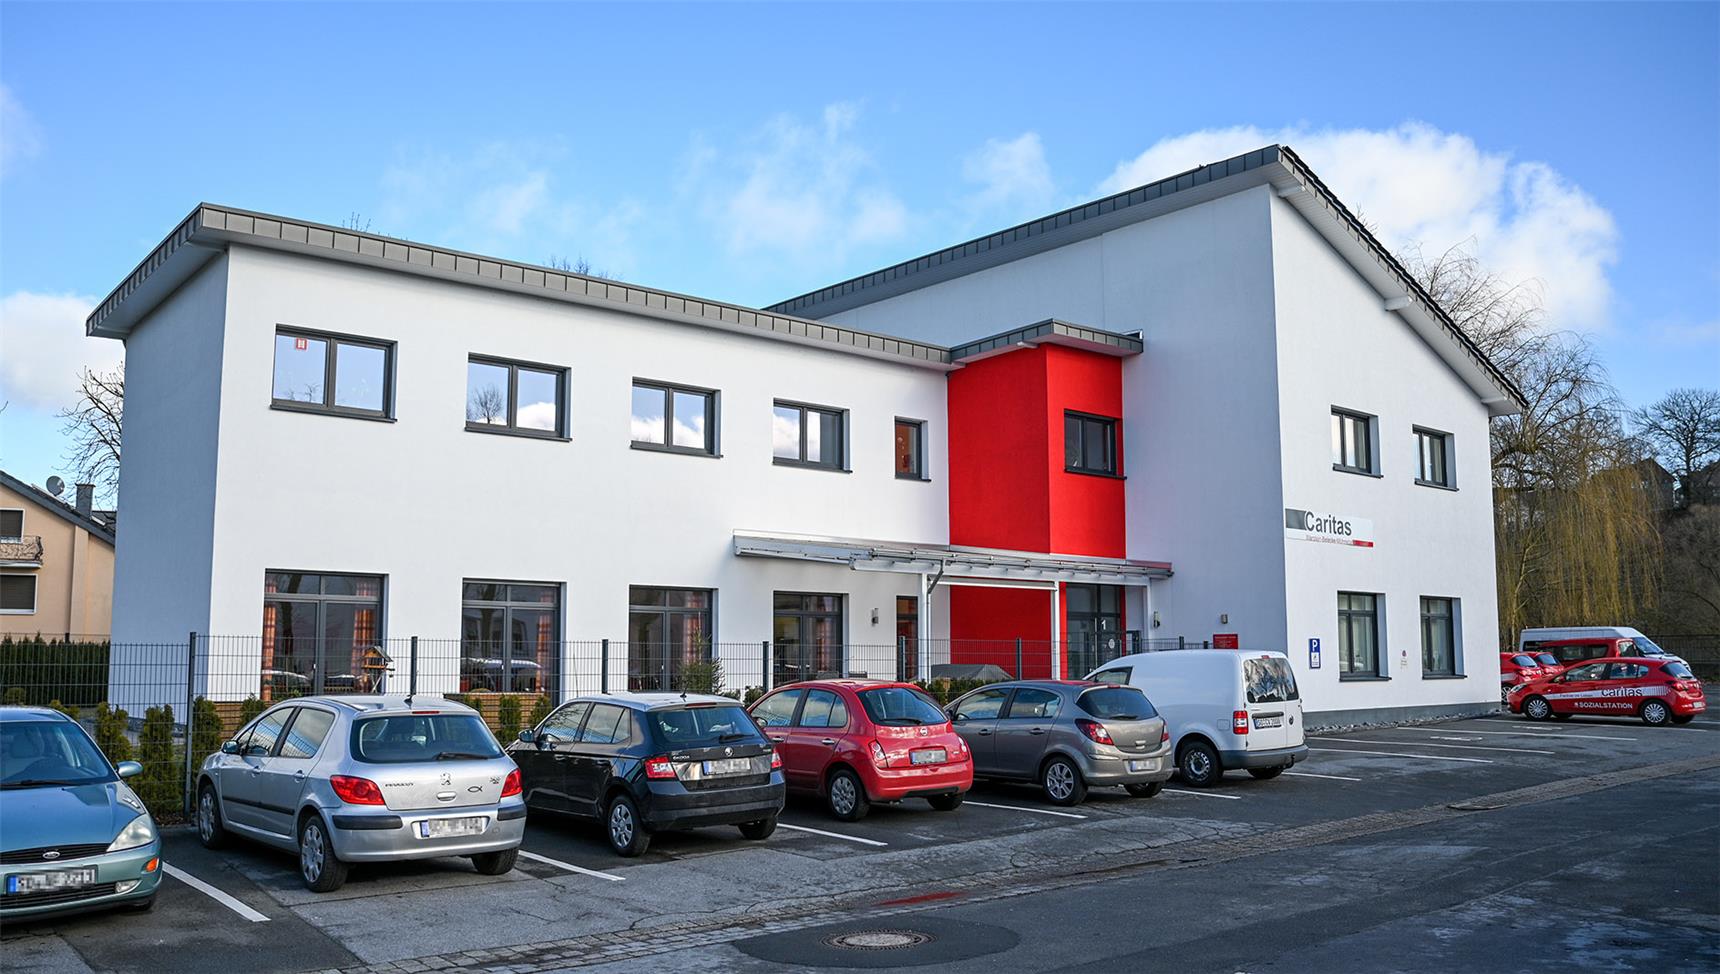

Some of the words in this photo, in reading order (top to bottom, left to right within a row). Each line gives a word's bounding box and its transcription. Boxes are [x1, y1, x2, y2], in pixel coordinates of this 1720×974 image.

[1306, 511, 1351, 536] Caritas
[1102, 620, 1106, 630] 1
[1312, 640, 1318, 652] P
[1601, 687, 1643, 697] caritas
